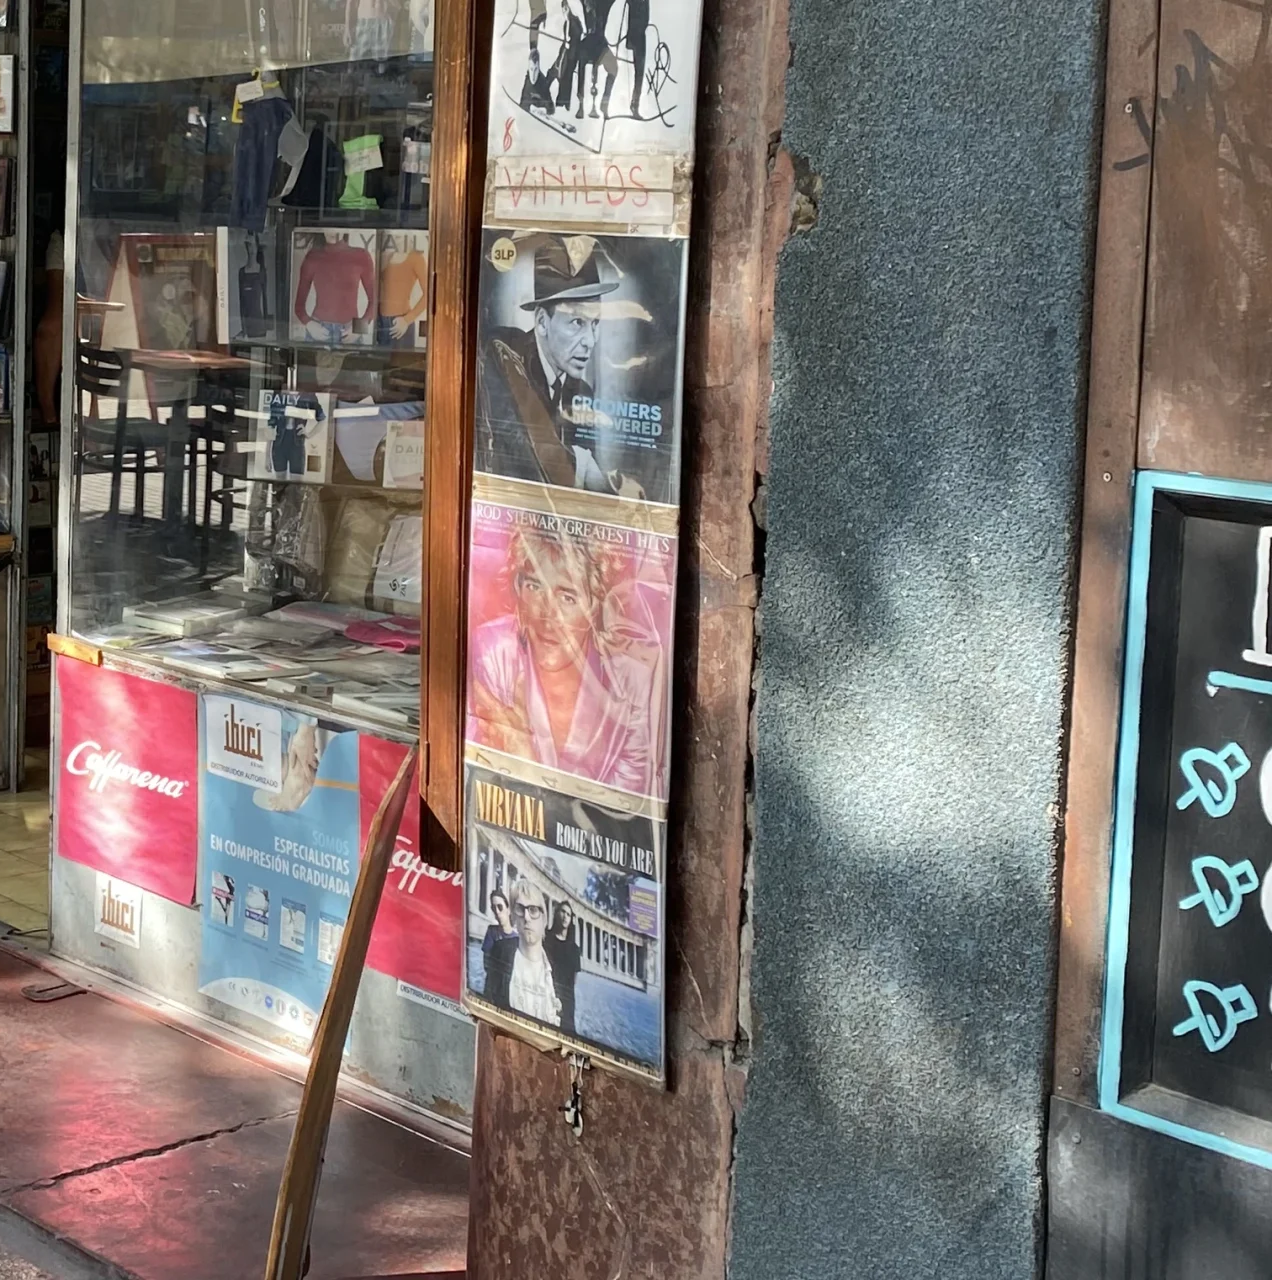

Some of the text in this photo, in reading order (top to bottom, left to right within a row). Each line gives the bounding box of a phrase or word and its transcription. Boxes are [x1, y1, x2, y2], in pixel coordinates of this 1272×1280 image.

[494, 248, 515, 261] 3LP
[263, 393, 301, 406] DAILY
[477, 505, 502, 520] ROD
[506, 510, 563, 532] STEWART
[565, 520, 634, 545] GREATEST
[636, 534, 670, 553] HITS
[66, 740, 186, 800] Caffarena
[210, 761, 244, 778] DISTRIBUIDOR
[245, 772, 279, 789] AUTORIZADO
[312, 829, 350, 856] SOMOS
[475, 779, 654, 876] NIRVANA ROME AS YOU ARE
[210, 833, 351, 898] EN COMPRESIÓN GRADUADA
[274, 836, 350, 876] ESPECIALISTAS
[400, 983, 441, 1005] DISTRIBUIDOR
